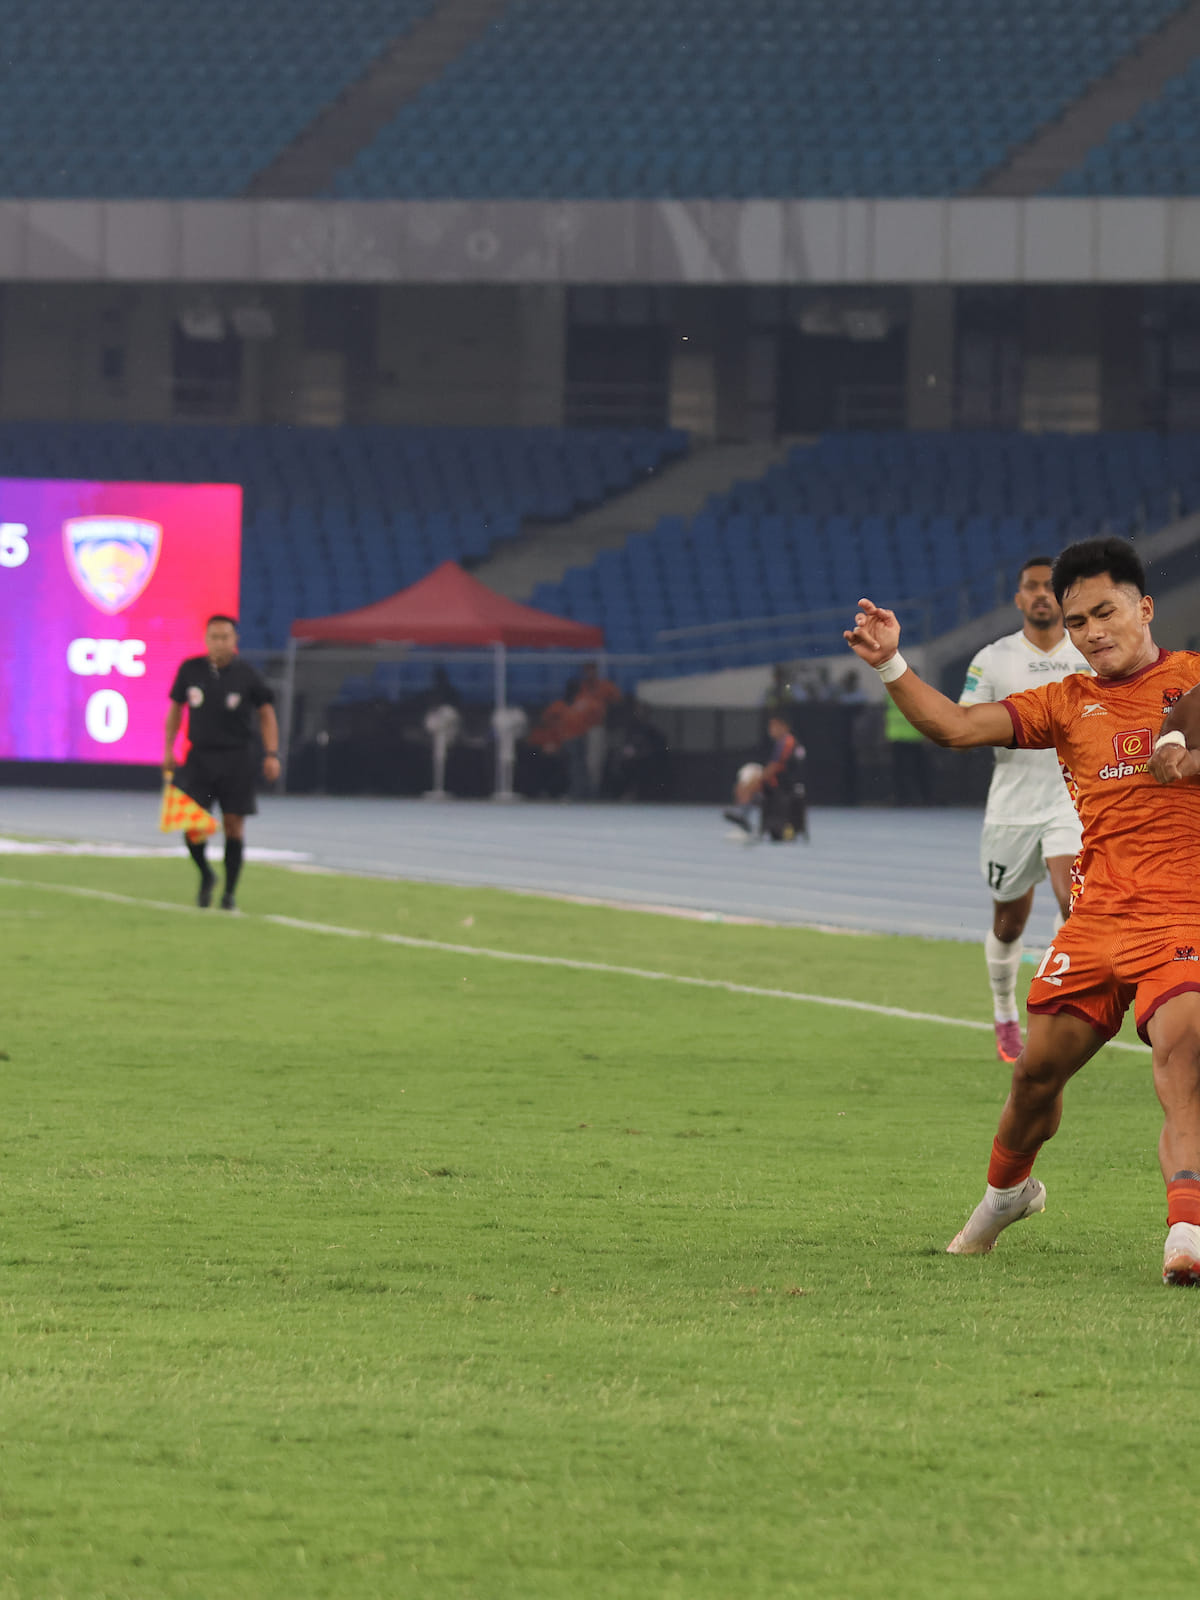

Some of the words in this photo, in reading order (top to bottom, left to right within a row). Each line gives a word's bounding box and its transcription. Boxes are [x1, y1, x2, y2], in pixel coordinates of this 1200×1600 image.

[67, 638, 146, 677] CFC
[1028, 661, 1071, 673] SSVM
[85, 689, 128, 743] 0
[988, 861, 1007, 890] 17
[1034, 945, 1070, 986] 12
